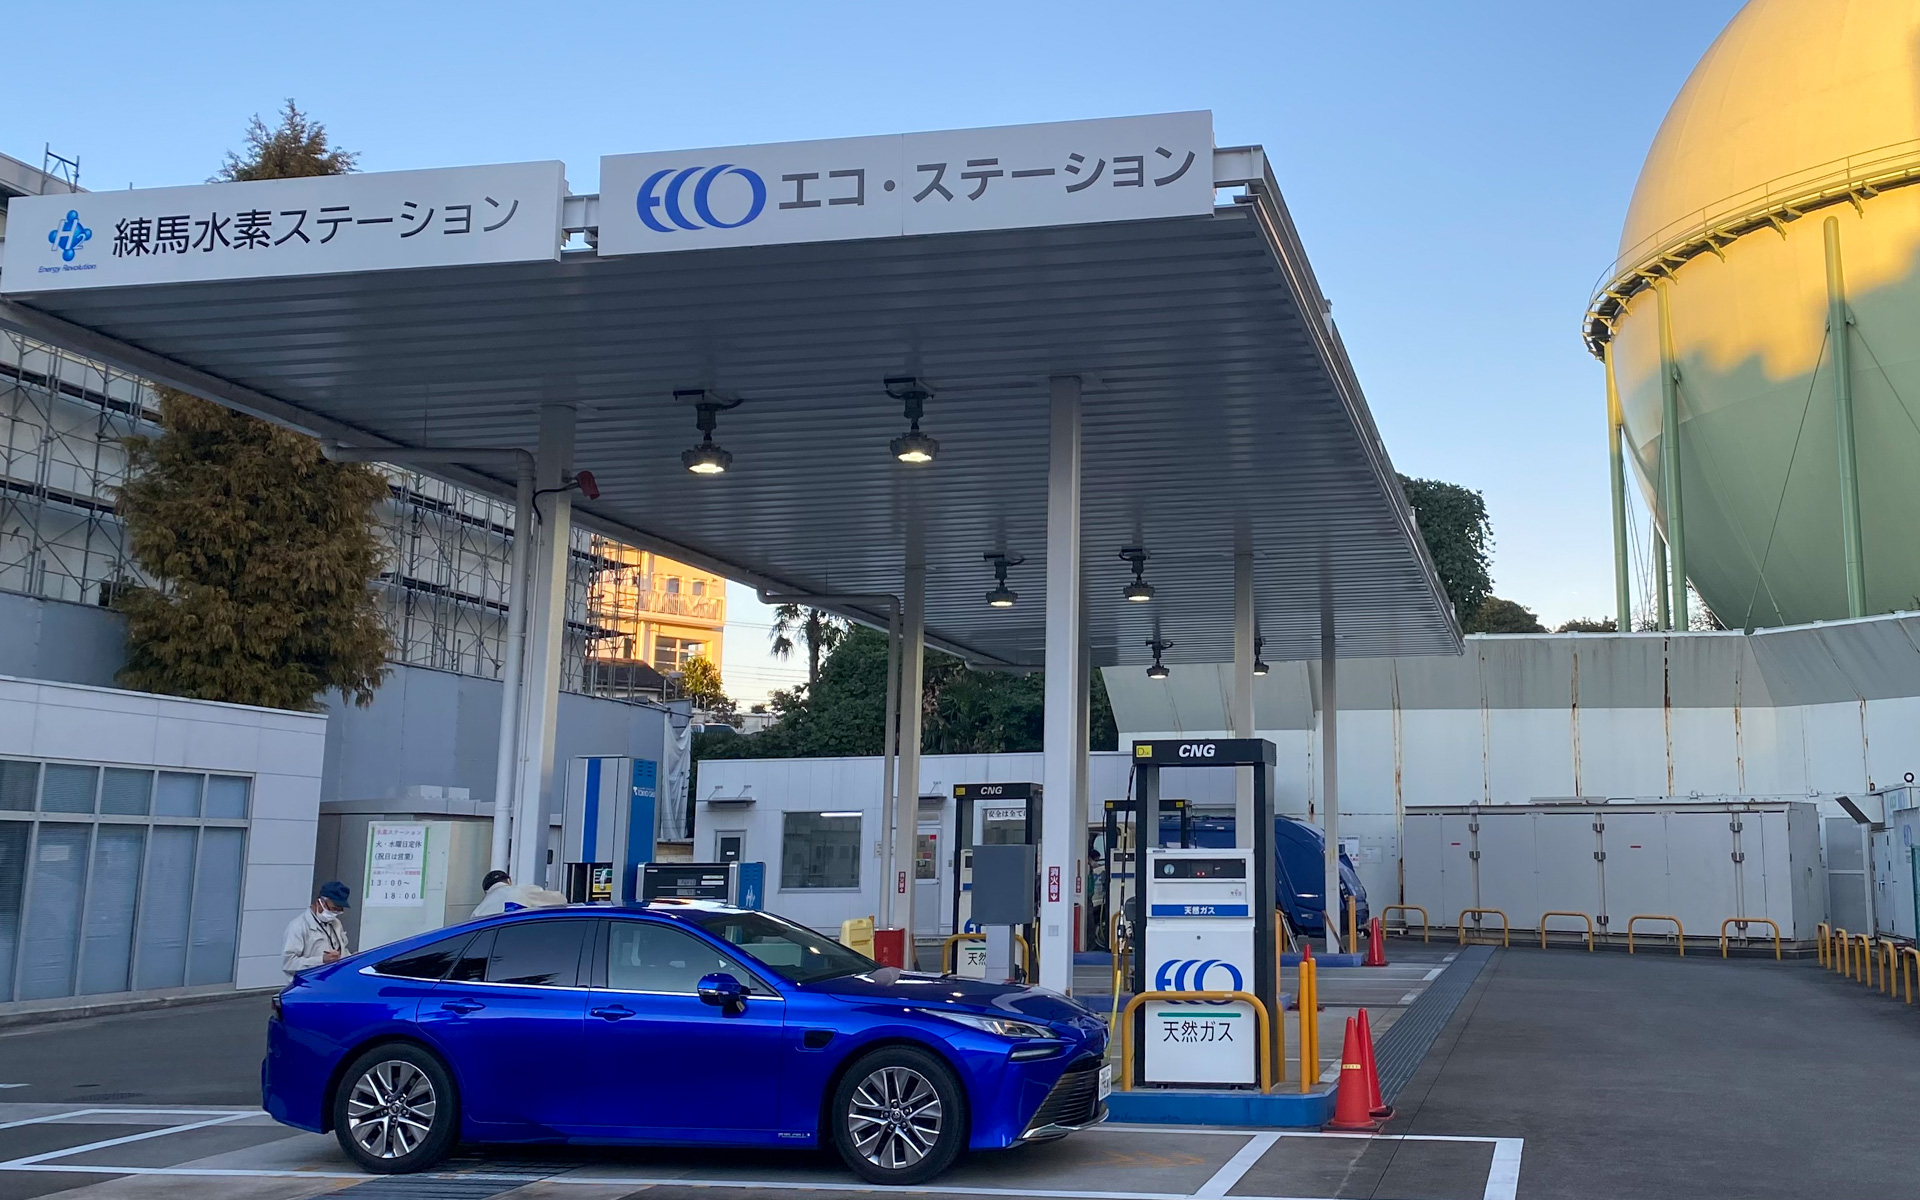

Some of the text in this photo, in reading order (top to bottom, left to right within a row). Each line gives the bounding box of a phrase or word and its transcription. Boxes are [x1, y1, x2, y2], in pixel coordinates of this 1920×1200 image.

[778, 146, 1196, 211] エコ・ステーション
[636, 163, 767, 233] ECO
[112, 196, 519, 258] 練馬水素ステーション
[1178, 744, 1216, 757] CNG
[980, 786, 1003, 795] CNG
[1184, 906, 1215, 915] 天然ガス
[1155, 959, 1243, 1005] ECO
[1163, 1020, 1233, 1042] 天然ガス
